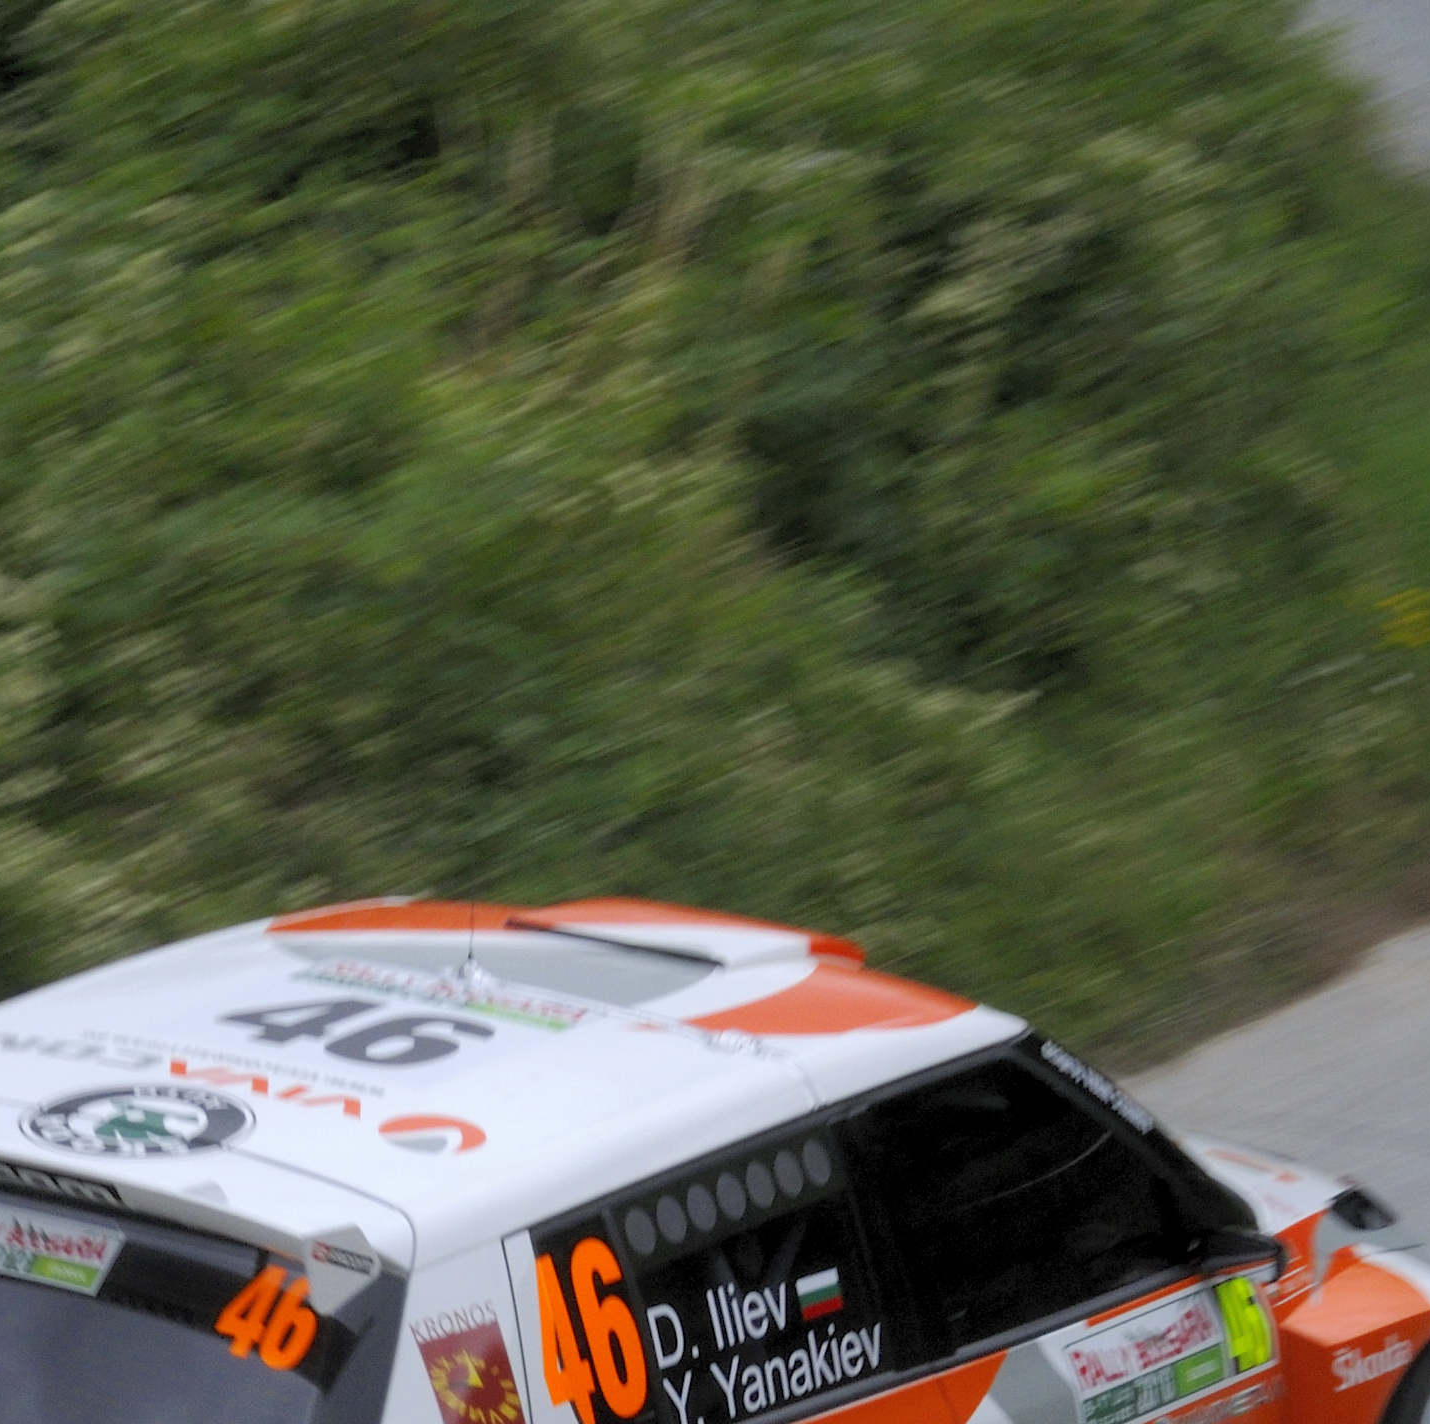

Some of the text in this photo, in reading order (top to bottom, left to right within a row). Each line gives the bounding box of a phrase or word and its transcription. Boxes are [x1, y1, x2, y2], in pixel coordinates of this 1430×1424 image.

[216, 999, 495, 1067] 46
[213, 1264, 318, 1371] 46
[408, 1299, 498, 1345] KRONOS
[647, 1281, 788, 1370] D. Iliev
[709, 1321, 882, 1420] Yanakiev
